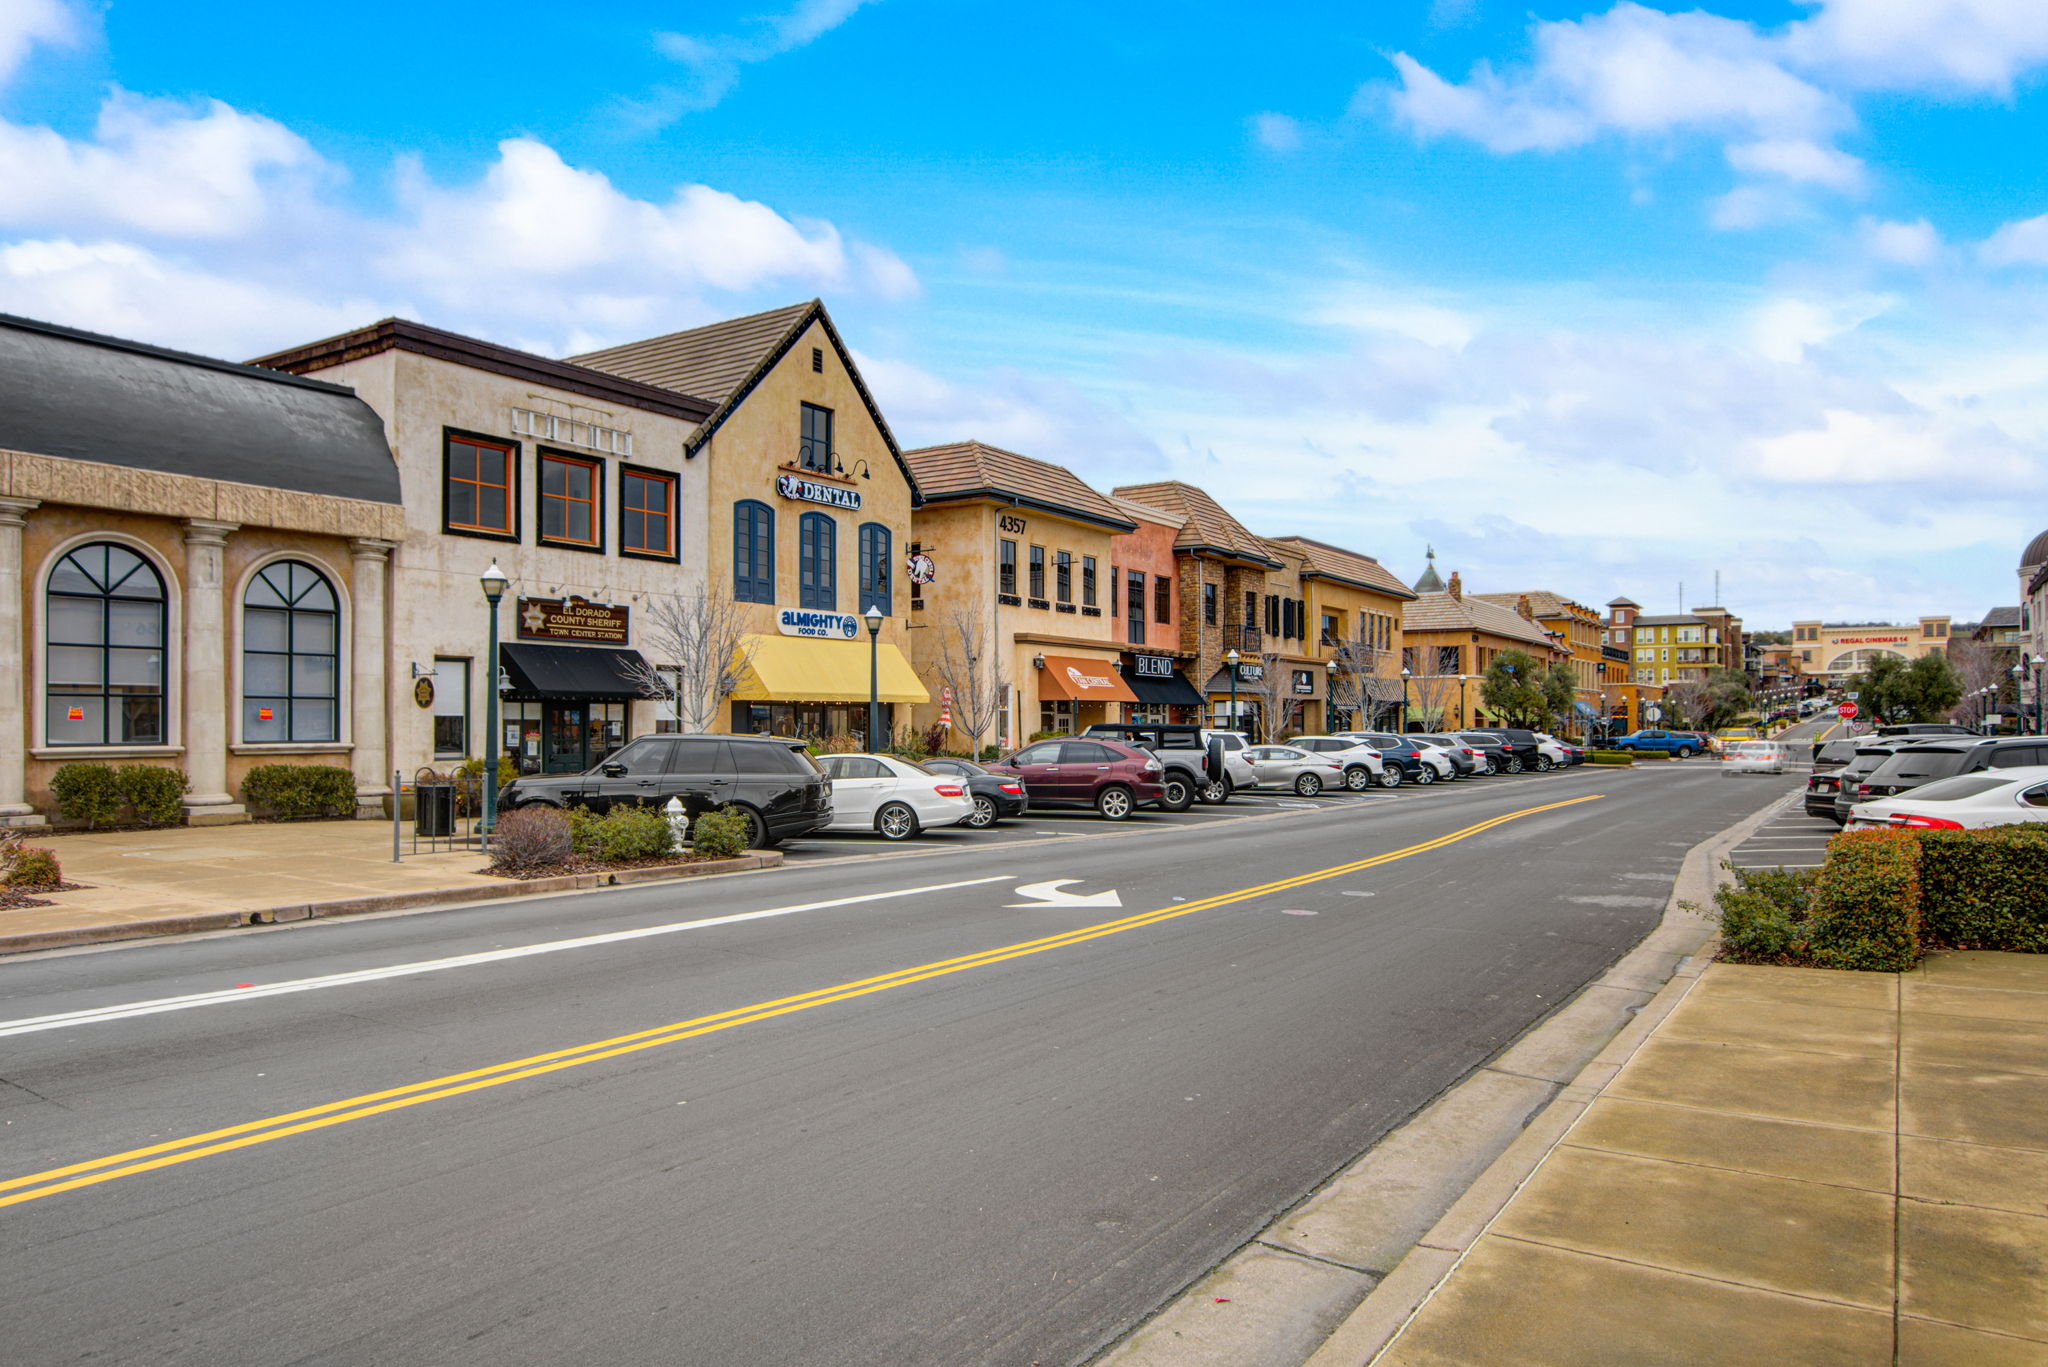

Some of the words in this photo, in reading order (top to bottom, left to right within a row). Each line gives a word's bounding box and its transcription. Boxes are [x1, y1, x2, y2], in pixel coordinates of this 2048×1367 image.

[803, 483, 859, 508] DENTAL
[1000, 515, 1026, 534] 4357
[563, 607, 575, 615] EL
[576, 608, 611, 618] DORADO
[550, 615, 586, 625] COUNTY
[587, 618, 622, 628] SHERIFF
[549, 628, 569, 636] TOWN
[1138, 657, 1172, 675] BLEND
[1840, 706, 1857, 714] STOP
